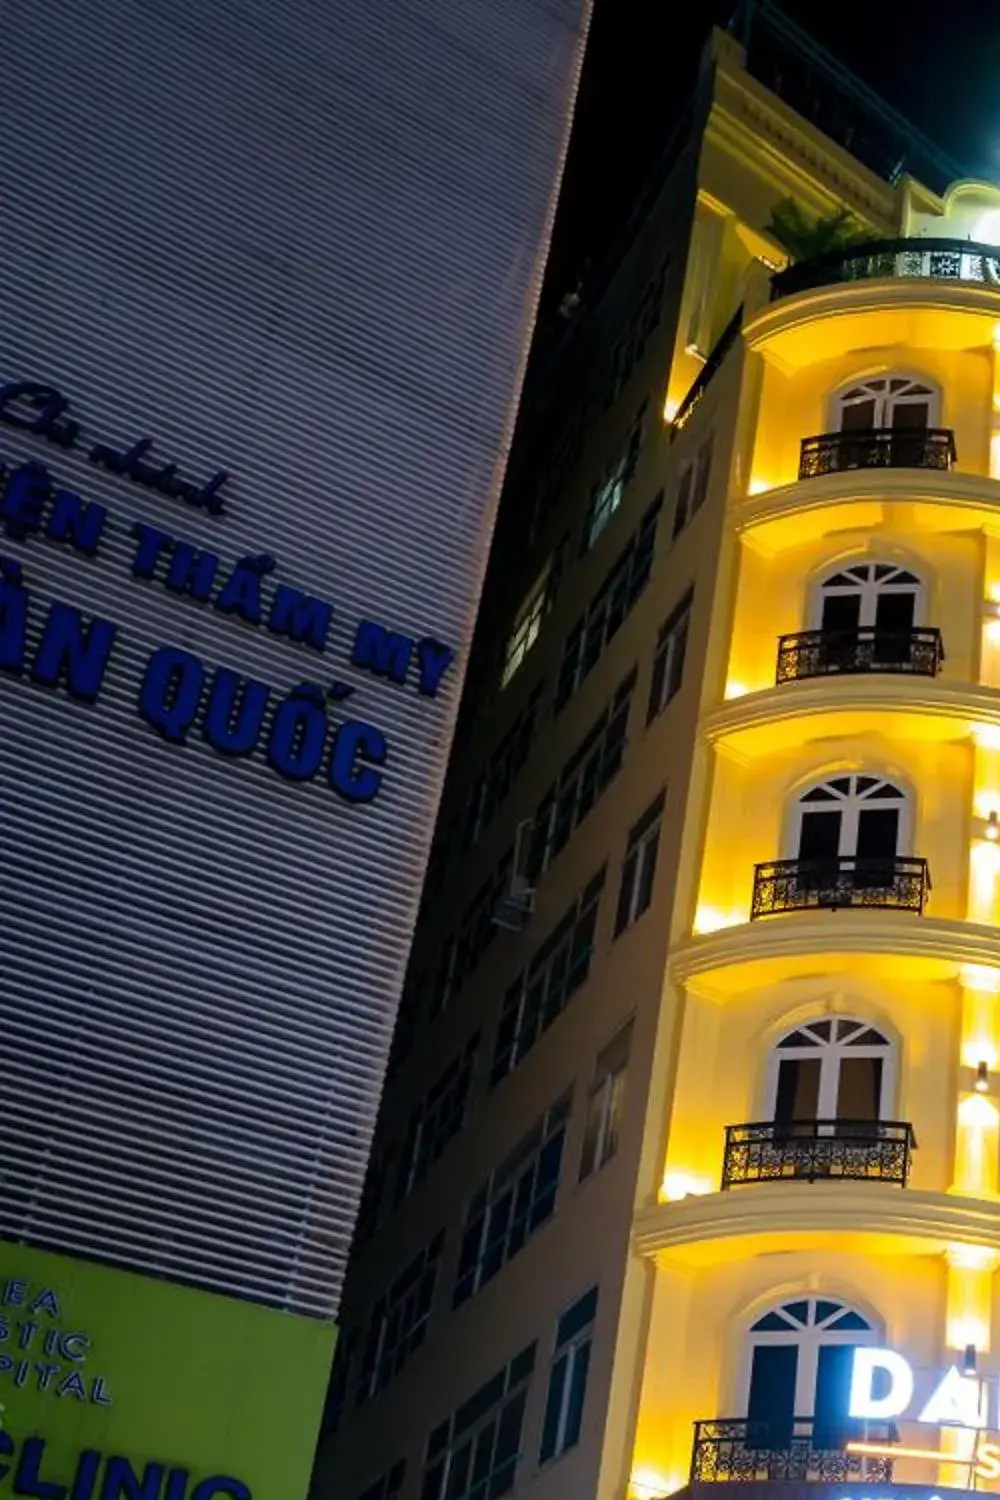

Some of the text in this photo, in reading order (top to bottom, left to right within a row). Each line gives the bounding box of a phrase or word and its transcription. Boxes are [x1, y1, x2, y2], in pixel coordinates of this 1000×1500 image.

[0, 460, 107, 557] ỆN
[350, 617, 457, 698] MỸ
[139, 646, 388, 802] QUỐC
